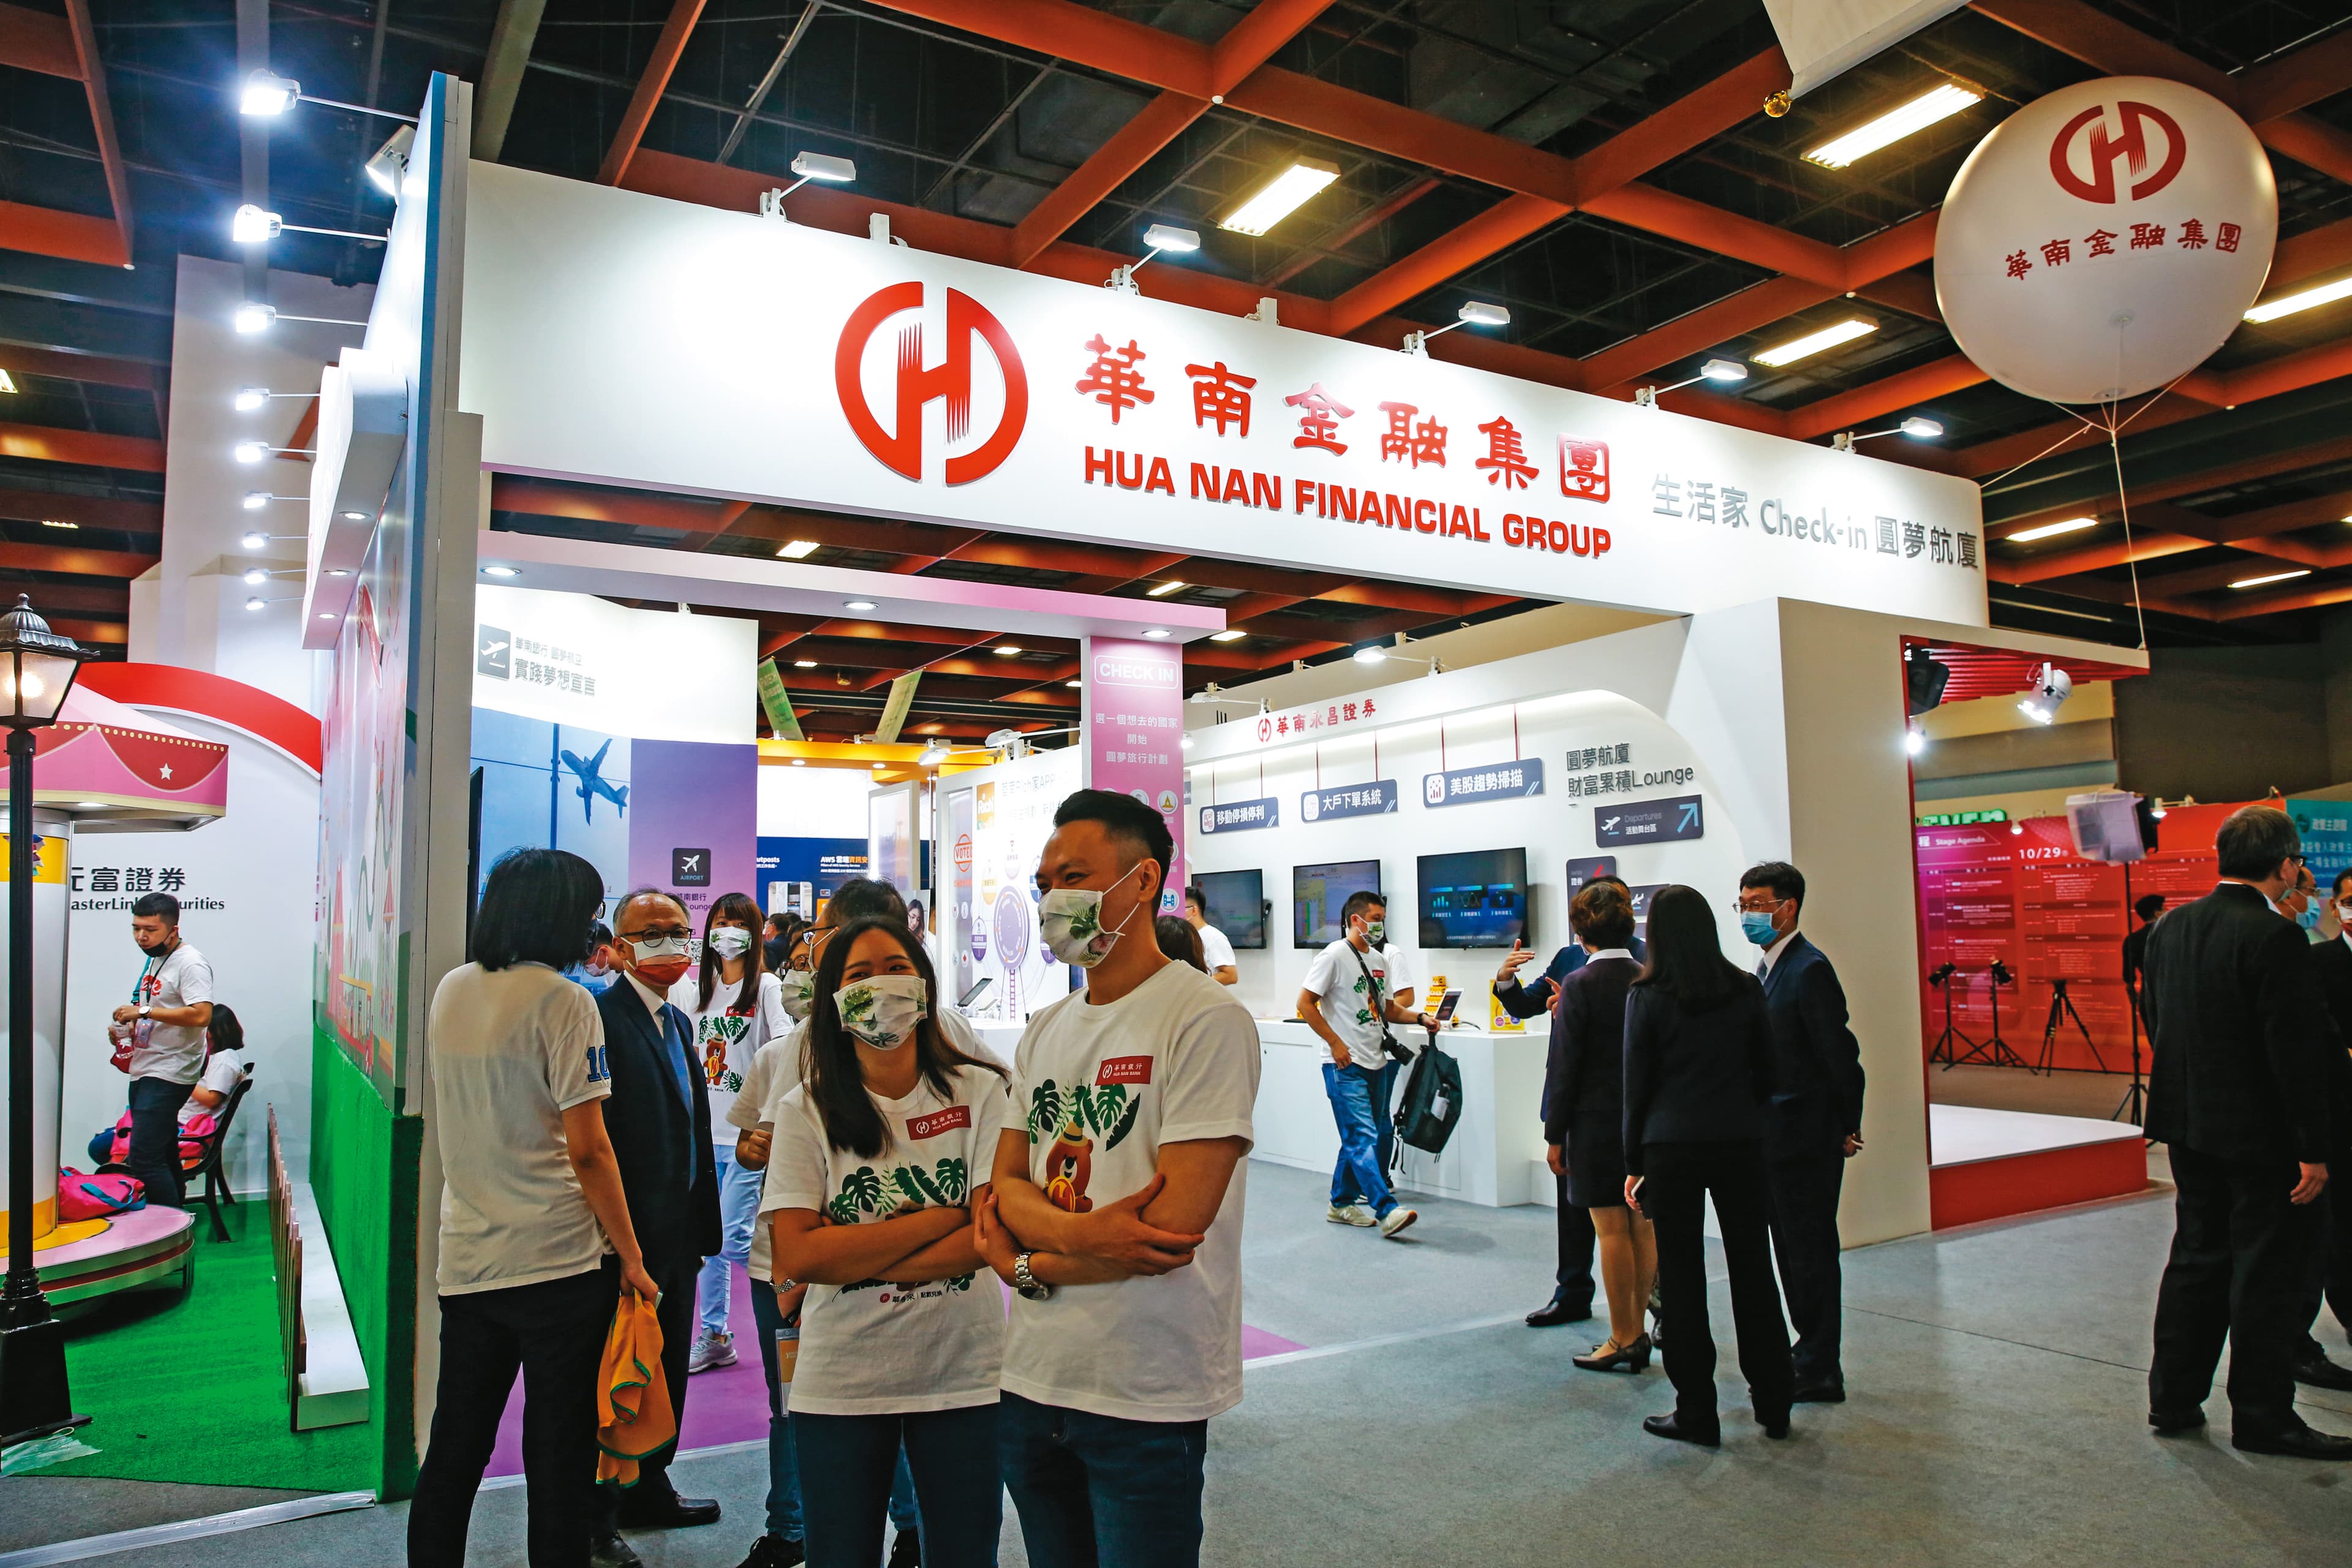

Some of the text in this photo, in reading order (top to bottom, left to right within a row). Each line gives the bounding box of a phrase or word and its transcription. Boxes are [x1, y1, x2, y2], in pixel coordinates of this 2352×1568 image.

[2005, 218, 2242, 281] 華南金融集團
[1075, 332, 1612, 505] 華南金融集團
[1084, 445, 1612, 559] HUA NAN FINANCIAL GROUP
[1651, 473, 1979, 570] 生活家 Check-in 圓夢航廈
[1099, 663, 1174, 682] CHECK IN
[1276, 698, 1376, 737] 華南永昌證券
[1566, 742, 1630, 772] 圓夢航廈
[1450, 767, 1523, 796] 美股趨勢掃描
[2019, 846, 2062, 859] 10/29
[71, 897, 225, 910] asterLin urities
